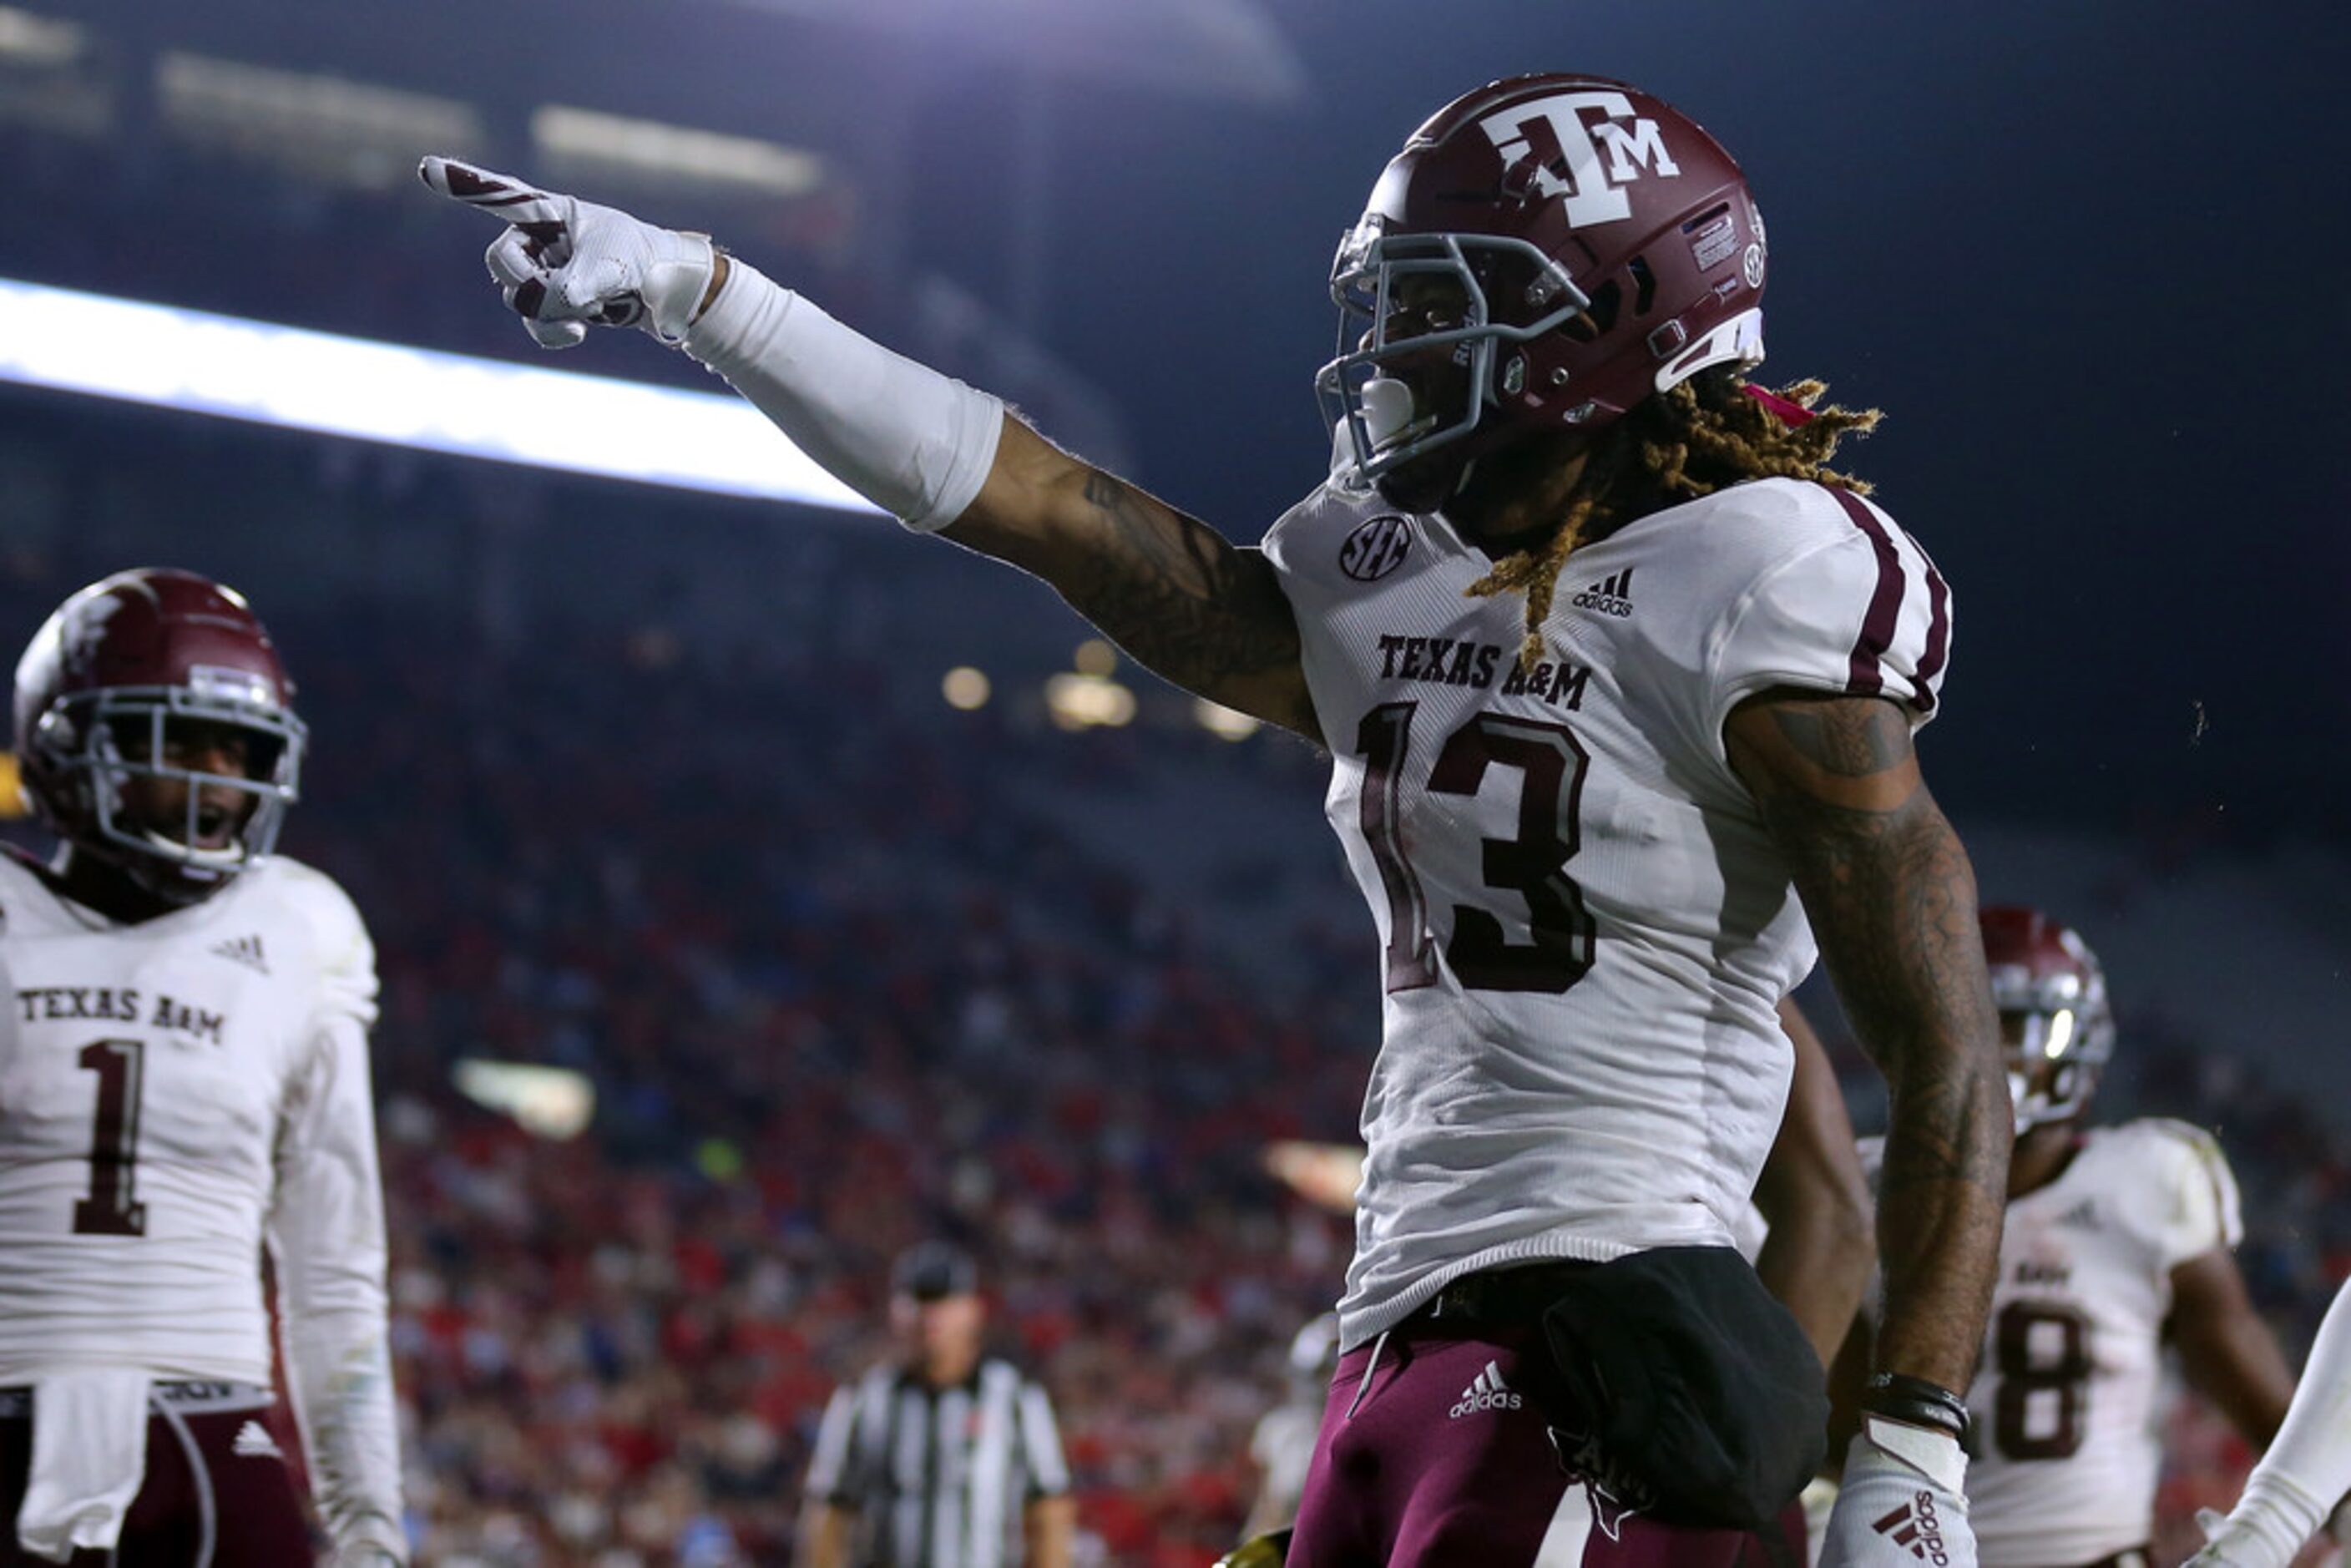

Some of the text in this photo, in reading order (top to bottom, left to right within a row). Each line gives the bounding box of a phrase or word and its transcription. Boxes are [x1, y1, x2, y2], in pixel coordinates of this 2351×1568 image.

[1342, 518, 1409, 580] SEC
[1572, 593, 1634, 618] adidas
[1378, 634, 1593, 711] TEXAS A&M
[1356, 701, 1597, 994] 13
[16, 988, 223, 1045] TEXAS A&M
[73, 1039, 146, 1236] 1
[1449, 1390, 1523, 1419] adidas
[1964, 1297, 2096, 1461] 8
[1914, 1490, 1949, 1566] adidas
